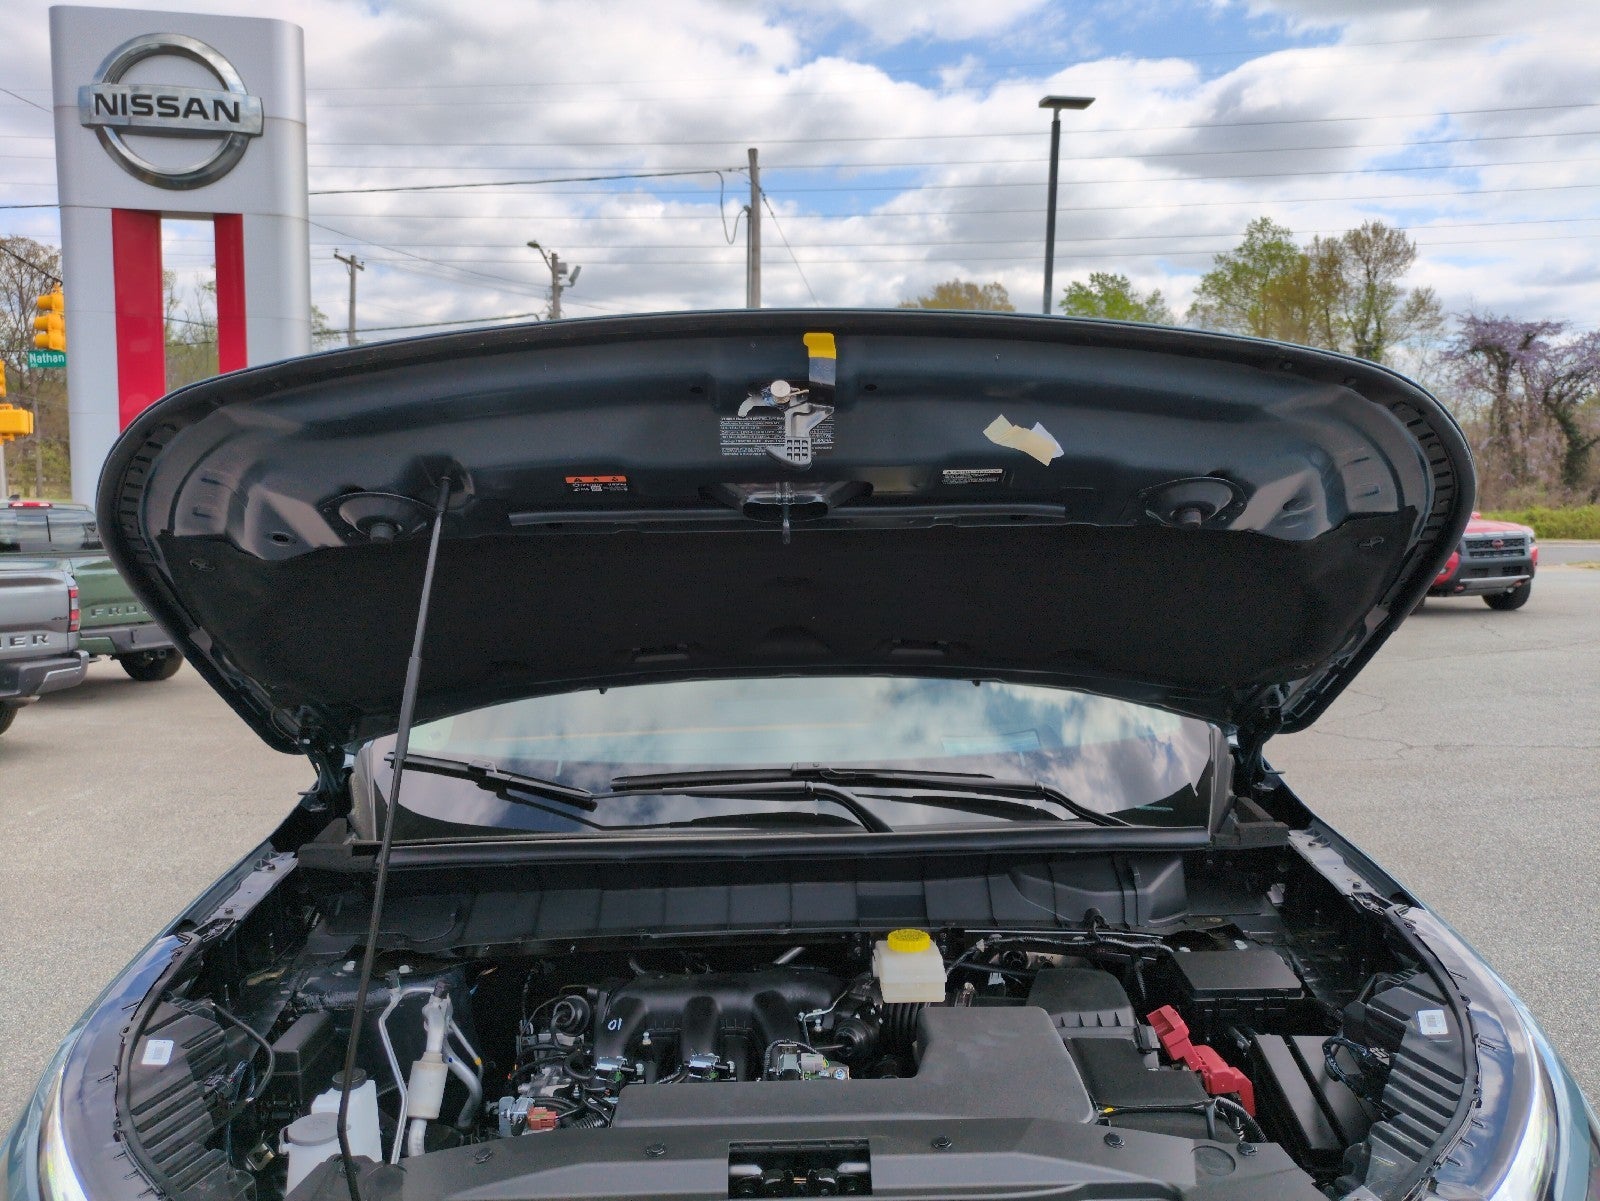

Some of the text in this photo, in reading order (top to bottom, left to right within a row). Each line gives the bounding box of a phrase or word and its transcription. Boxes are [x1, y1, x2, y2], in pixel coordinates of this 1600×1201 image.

[94, 93, 240, 124] NISSAN
[29, 353, 65, 364] Nathan
[90, 605, 149, 618] FRO
[0, 633, 50, 649] ER
